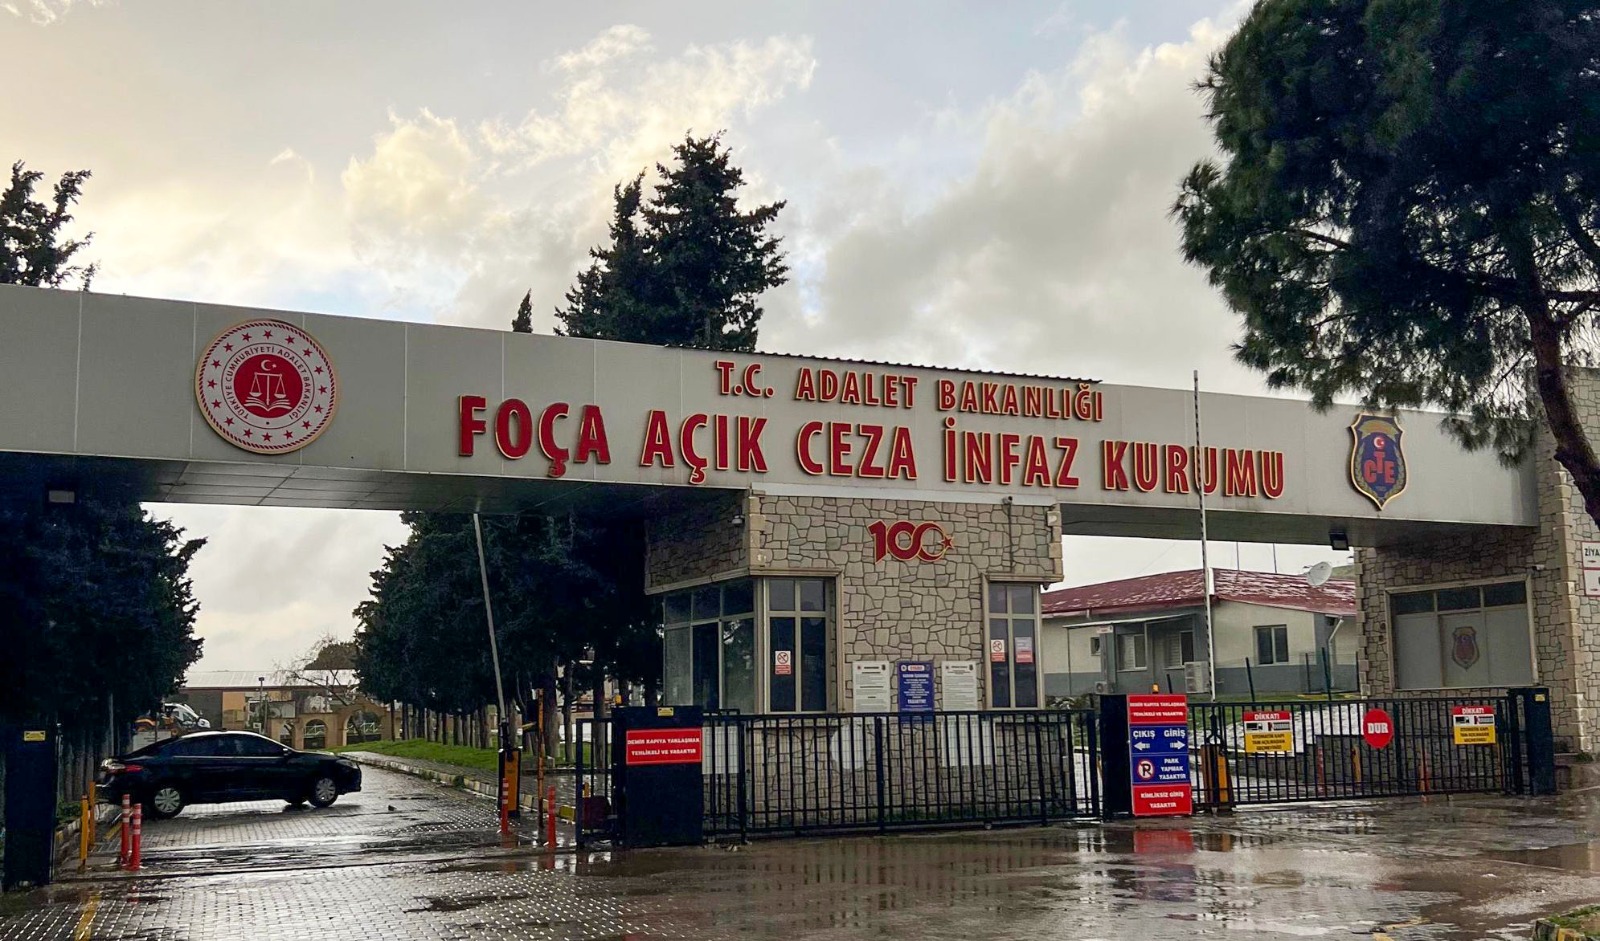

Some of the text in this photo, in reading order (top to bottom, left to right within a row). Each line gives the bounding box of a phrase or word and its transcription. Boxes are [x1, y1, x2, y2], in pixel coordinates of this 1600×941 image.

[225, 345, 311, 421] TÜRKİYE CUMHURİYETİ ADALET BAKANLIĞI
[715, 360, 1104, 421] T.C. ADALET BAKANLIĞI
[458, 394, 1285, 499] FOÇA AÇIK CEZA İNFAZ KURUMU
[867, 519, 947, 564] 100
[1584, 546, 1600, 557] ZİYA
[1132, 728, 1186, 740] ÇIKIŞ GİRİŞ
[1367, 722, 1389, 734] DUR
[1169, 791, 1185, 799] GİRİŞ
